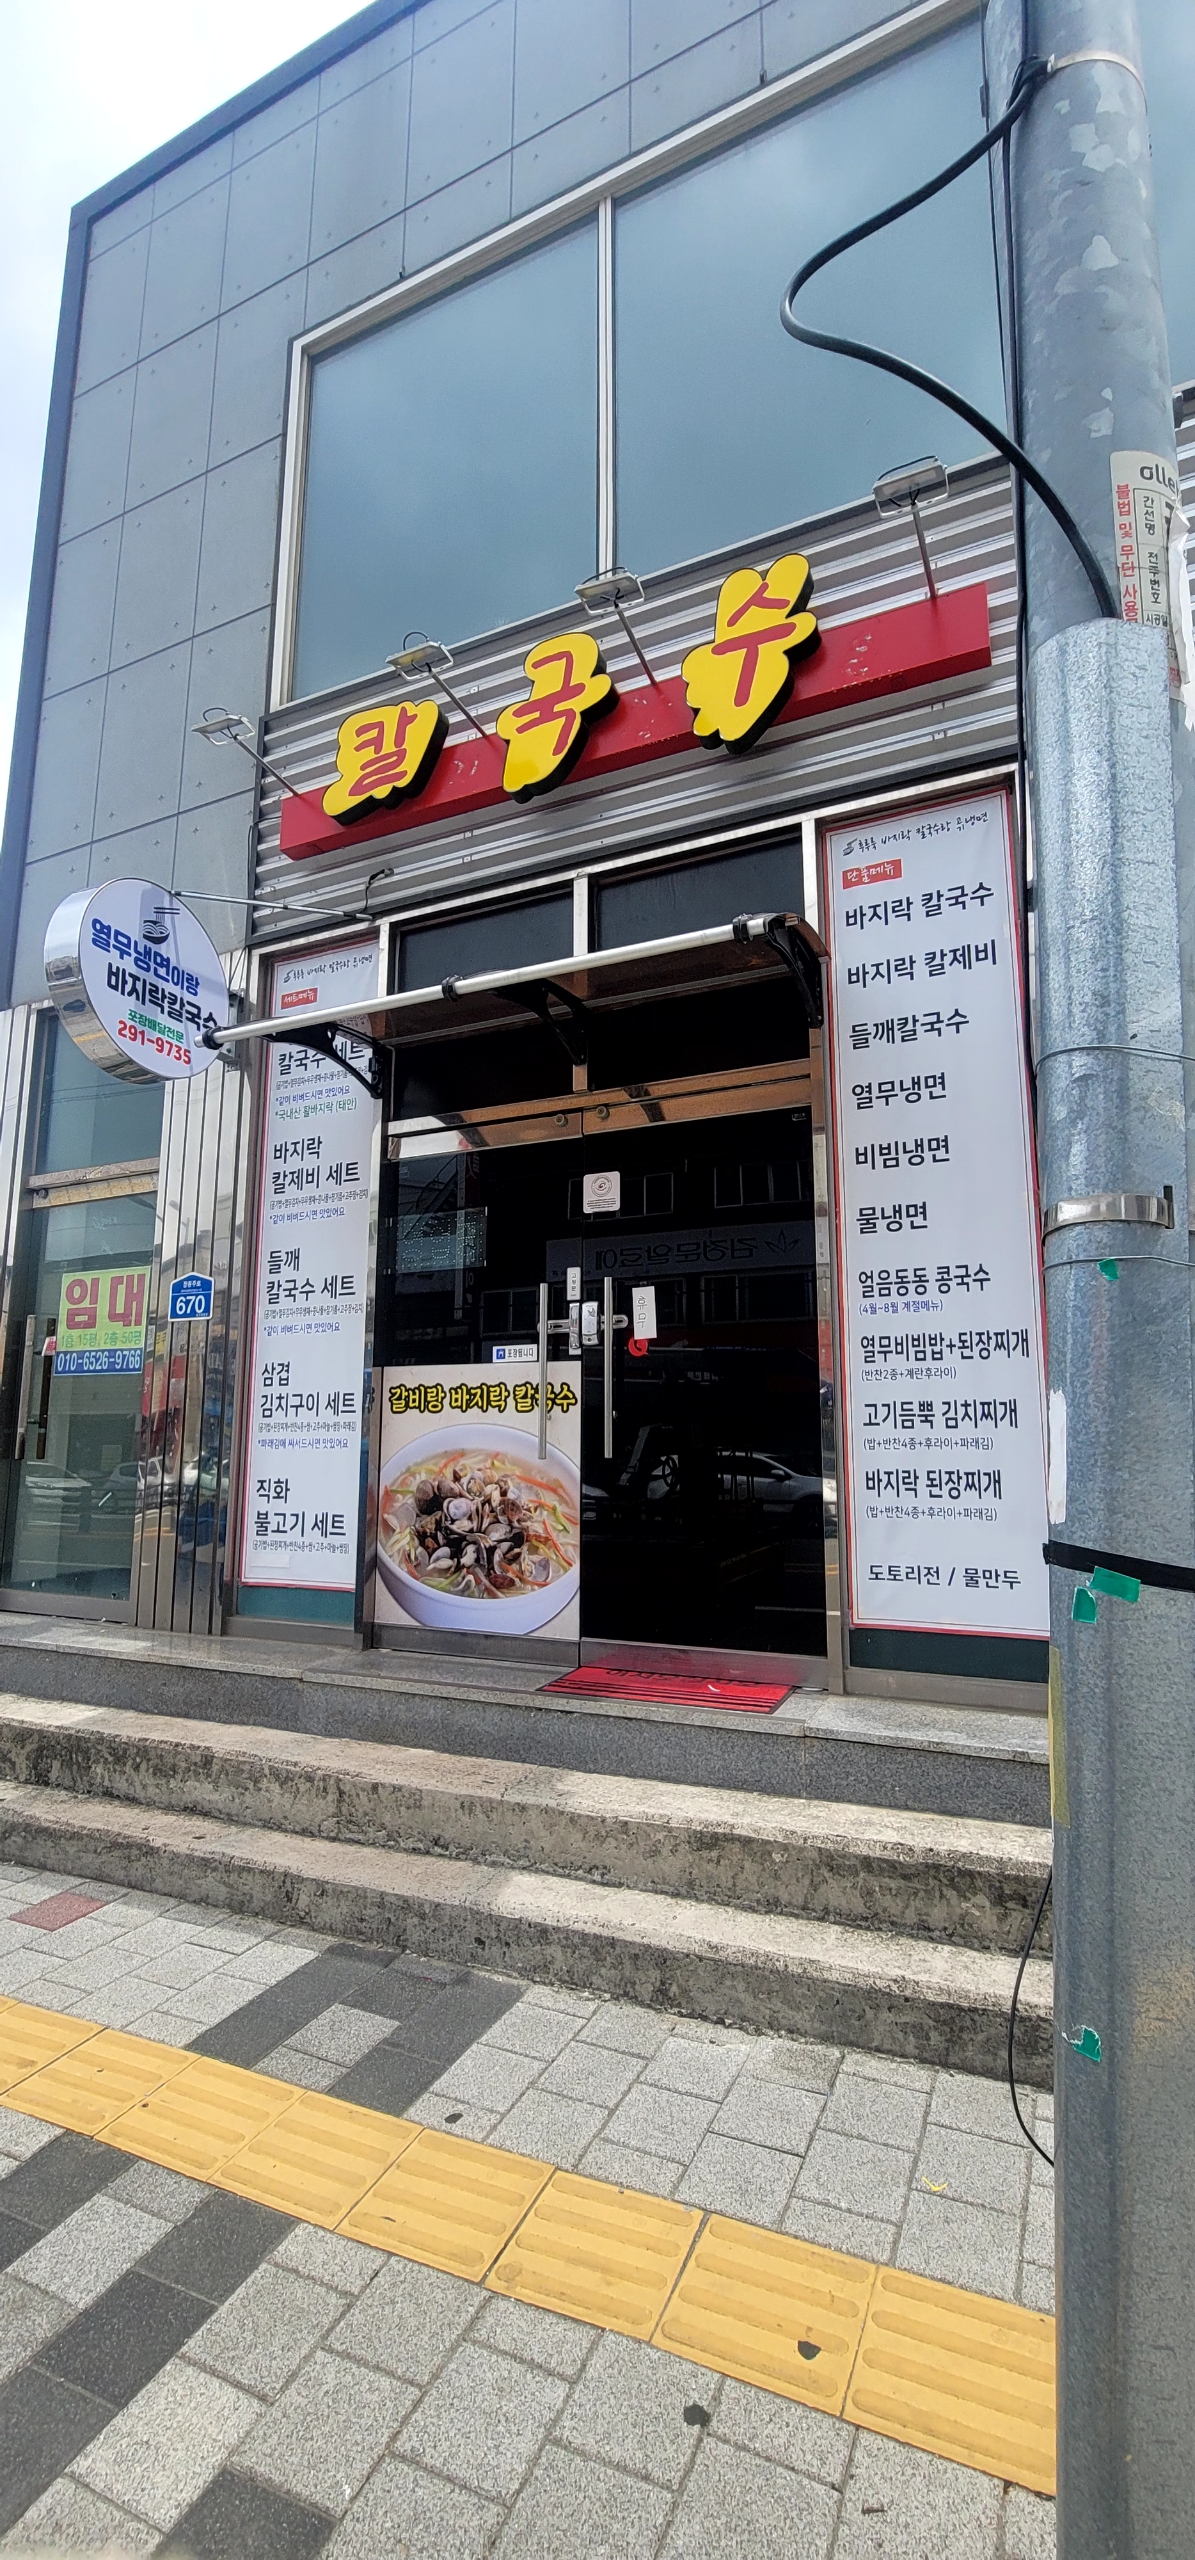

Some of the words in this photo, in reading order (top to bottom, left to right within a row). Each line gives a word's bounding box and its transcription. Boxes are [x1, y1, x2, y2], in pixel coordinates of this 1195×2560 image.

[1116, 483, 1131, 517] 불법
[1143, 495, 1155, 536] 간선명
[1118, 523, 1132, 539] 및
[1119, 544, 1136, 578] 무단
[1147, 551, 1161, 604] 전주번호
[349, 582, 797, 796] 칼국수
[881, 829, 912, 845] 바지락
[915, 821, 952, 840] 칼국수랑
[846, 862, 895, 883] 단품메뉴
[845, 897, 913, 930] 바지락
[921, 882, 994, 918] 칼국수
[91, 917, 201, 997] 열무냉면이랑
[847, 955, 916, 989] 바지락
[924, 939, 997, 977] 칼제비
[106, 961, 218, 1033] 바지락칼국수
[284, 990, 315, 1003] 세트메뉴
[128, 1009, 184, 1044] 포장배달전문
[849, 1008, 969, 1050] 들깨칼국수
[117, 1019, 192, 1066] 291-9735
[278, 1048, 327, 1076] 칼국수
[292, 1089, 324, 1103] 비벼드시면
[325, 1085, 350, 1098] 맛있어요
[851, 1072, 947, 1110] 열무냉면
[302, 1101, 334, 1118] 활바지락
[335, 1097, 357, 1113] (태안)
[273, 1135, 323, 1165] 바지락
[855, 1134, 950, 1170] 비빔냉면
[272, 1165, 321, 1195] 칼제비
[326, 1161, 361, 1186] 세트
[286, 1209, 318, 1223] 비벼드시면
[319, 1206, 345, 1219] 맛있어요
[856, 1201, 929, 1234] 물냉면
[267, 1248, 301, 1274] 들깨
[266, 1279, 315, 1305] 칼국수
[321, 1275, 356, 1300] 세트
[858, 1266, 930, 1299] 얼음동동
[934, 1263, 991, 1295] 콩국수
[65, 1273, 146, 1330] 임대
[176, 1295, 205, 1315] 670
[859, 1302, 899, 1315] (4월~8월
[901, 1299, 943, 1313] 계절메뉴)
[61, 1335, 74, 1348] 1층
[104, 1332, 117, 1346] 2층
[120, 1330, 142, 1345] 50평
[280, 1323, 312, 1335] 비벼드시면
[314, 1321, 340, 1333] 맛있어요
[57, 1350, 140, 1371] 010-6526-9766
[860, 1328, 1030, 1364] 열무비빔밥+된장찌개
[261, 1361, 291, 1388] 삼겹
[861, 1366, 957, 1382] (반찬2종+계란후라이)
[260, 1392, 320, 1420] 김치구이
[325, 1391, 356, 1416] 세트
[389, 1383, 446, 1414] 갈비랑
[449, 1381, 509, 1414] 바지락
[863, 1401, 936, 1430] 고기듬뿍
[942, 1399, 1018, 1429] 김치찌개
[287, 1438, 321, 1450] 싸서드시면
[322, 1438, 349, 1449] 맛있어요
[863, 1437, 994, 1451] (밥+반찬4종+후라이+파래김)
[256, 1478, 290, 1504] 직화
[865, 1468, 920, 1498] 바지락
[925, 1469, 1002, 1500] 된장찌개
[254, 1511, 306, 1539] 불고기
[311, 1513, 347, 1538] 세트
[866, 1506, 998, 1522] (밥+반찬4종+후라이+파래김)
[868, 1564, 941, 1586] 도토리전
[947, 1567, 956, 1587] /
[962, 1568, 1021, 1590] 물만두
